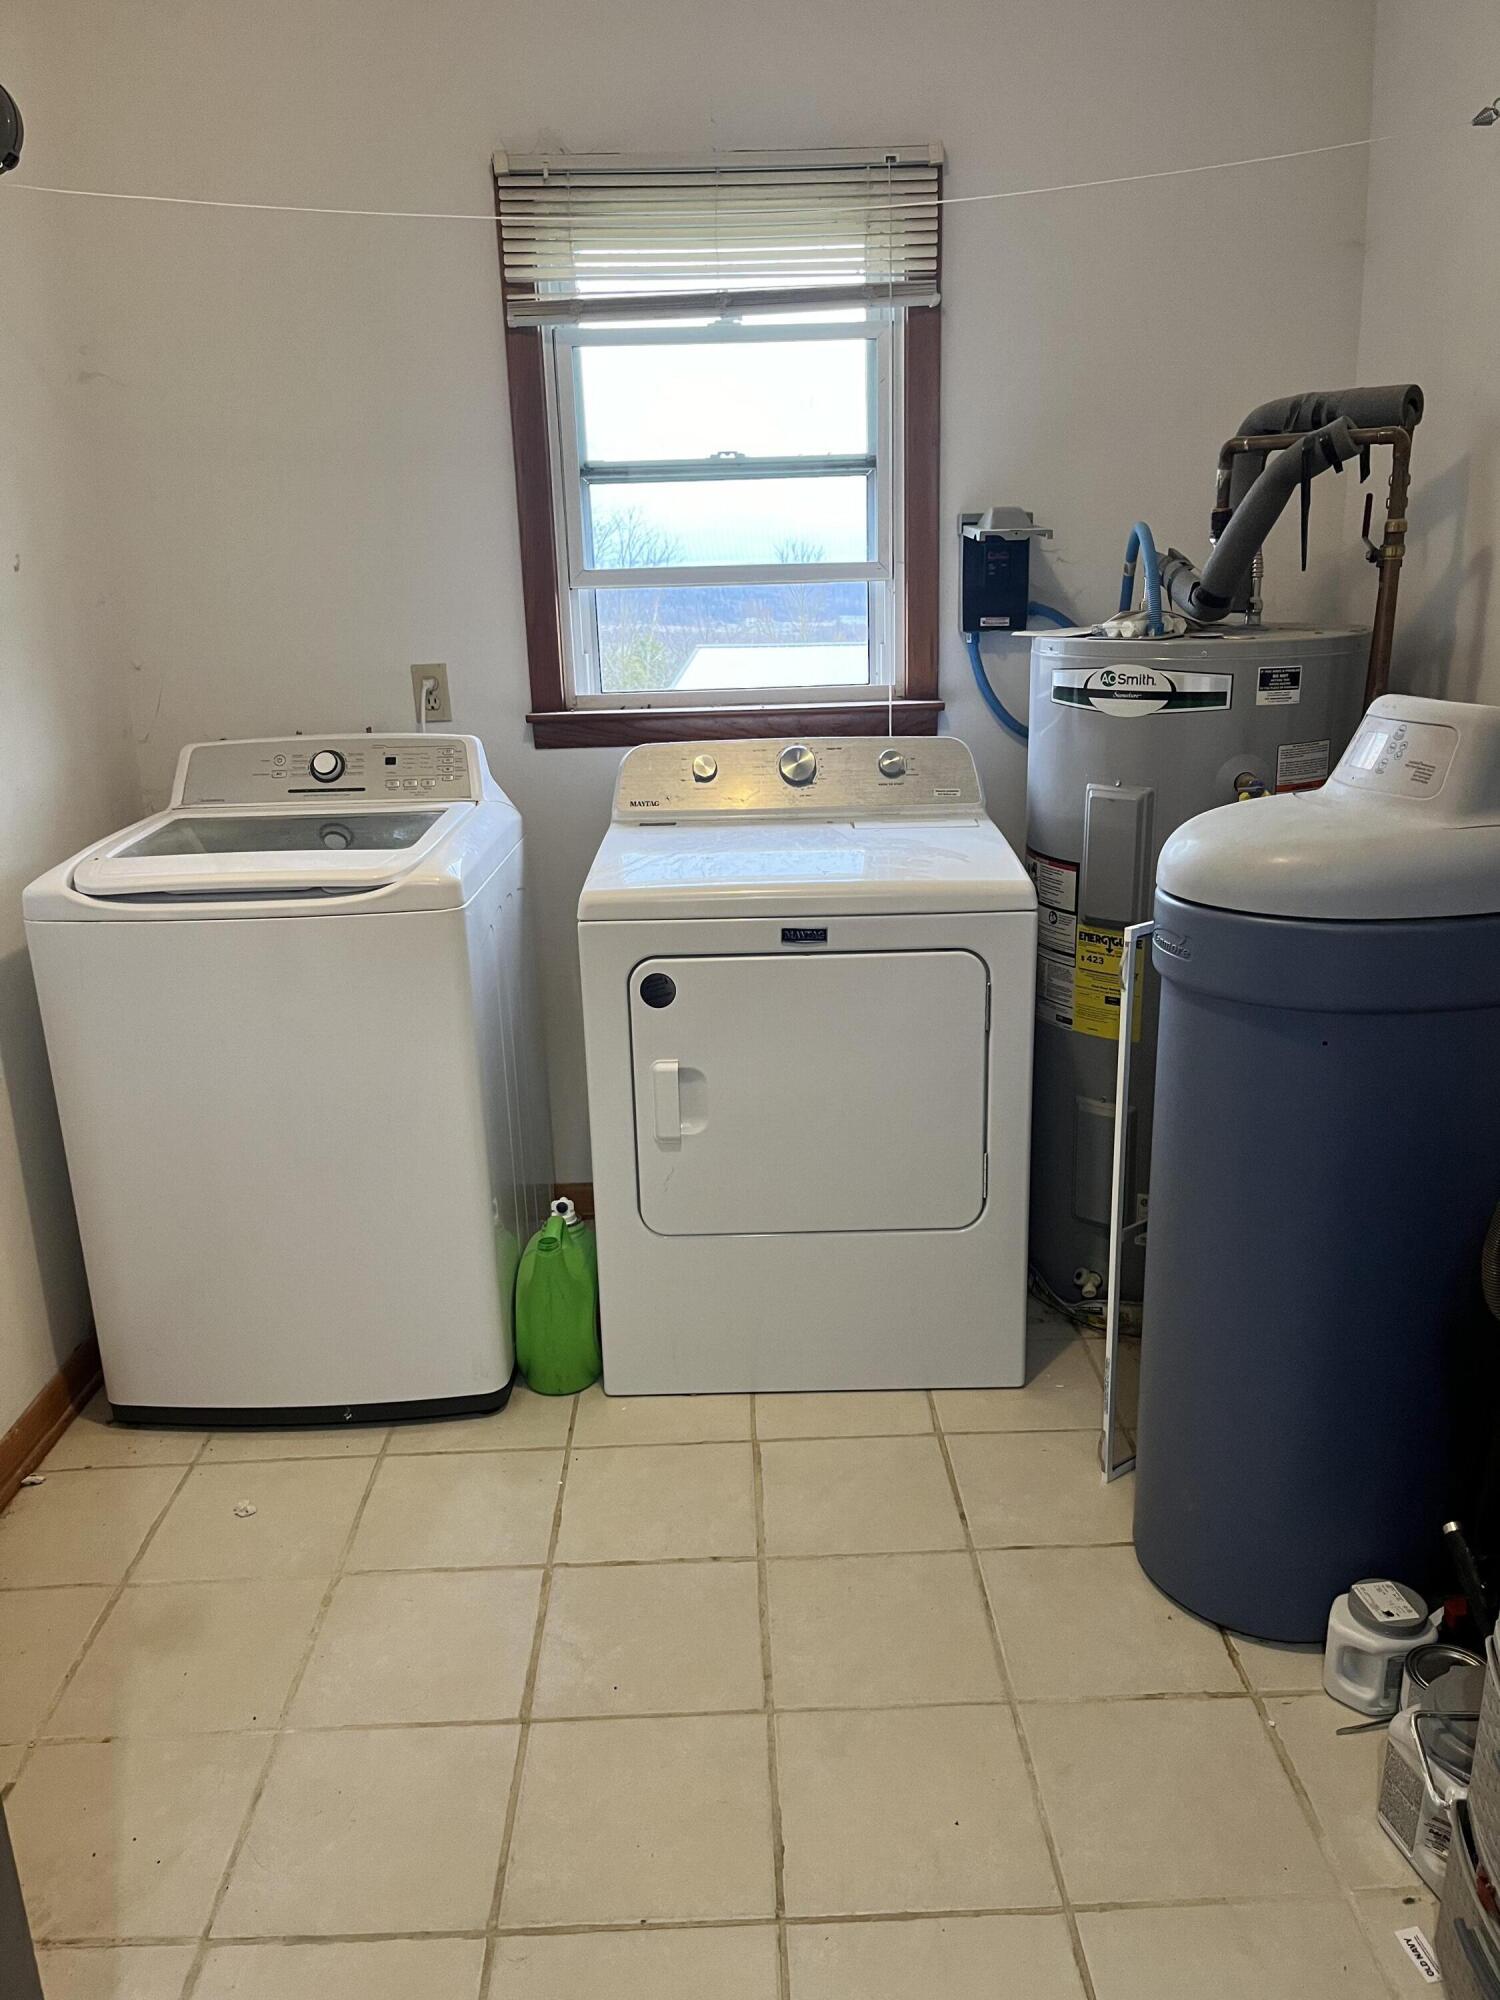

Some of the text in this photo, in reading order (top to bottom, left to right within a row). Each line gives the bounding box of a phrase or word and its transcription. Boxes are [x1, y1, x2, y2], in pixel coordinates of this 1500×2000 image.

[1086, 954, 1104, 965] 423
[1403, 1938, 1434, 1977] OLD NAVY
